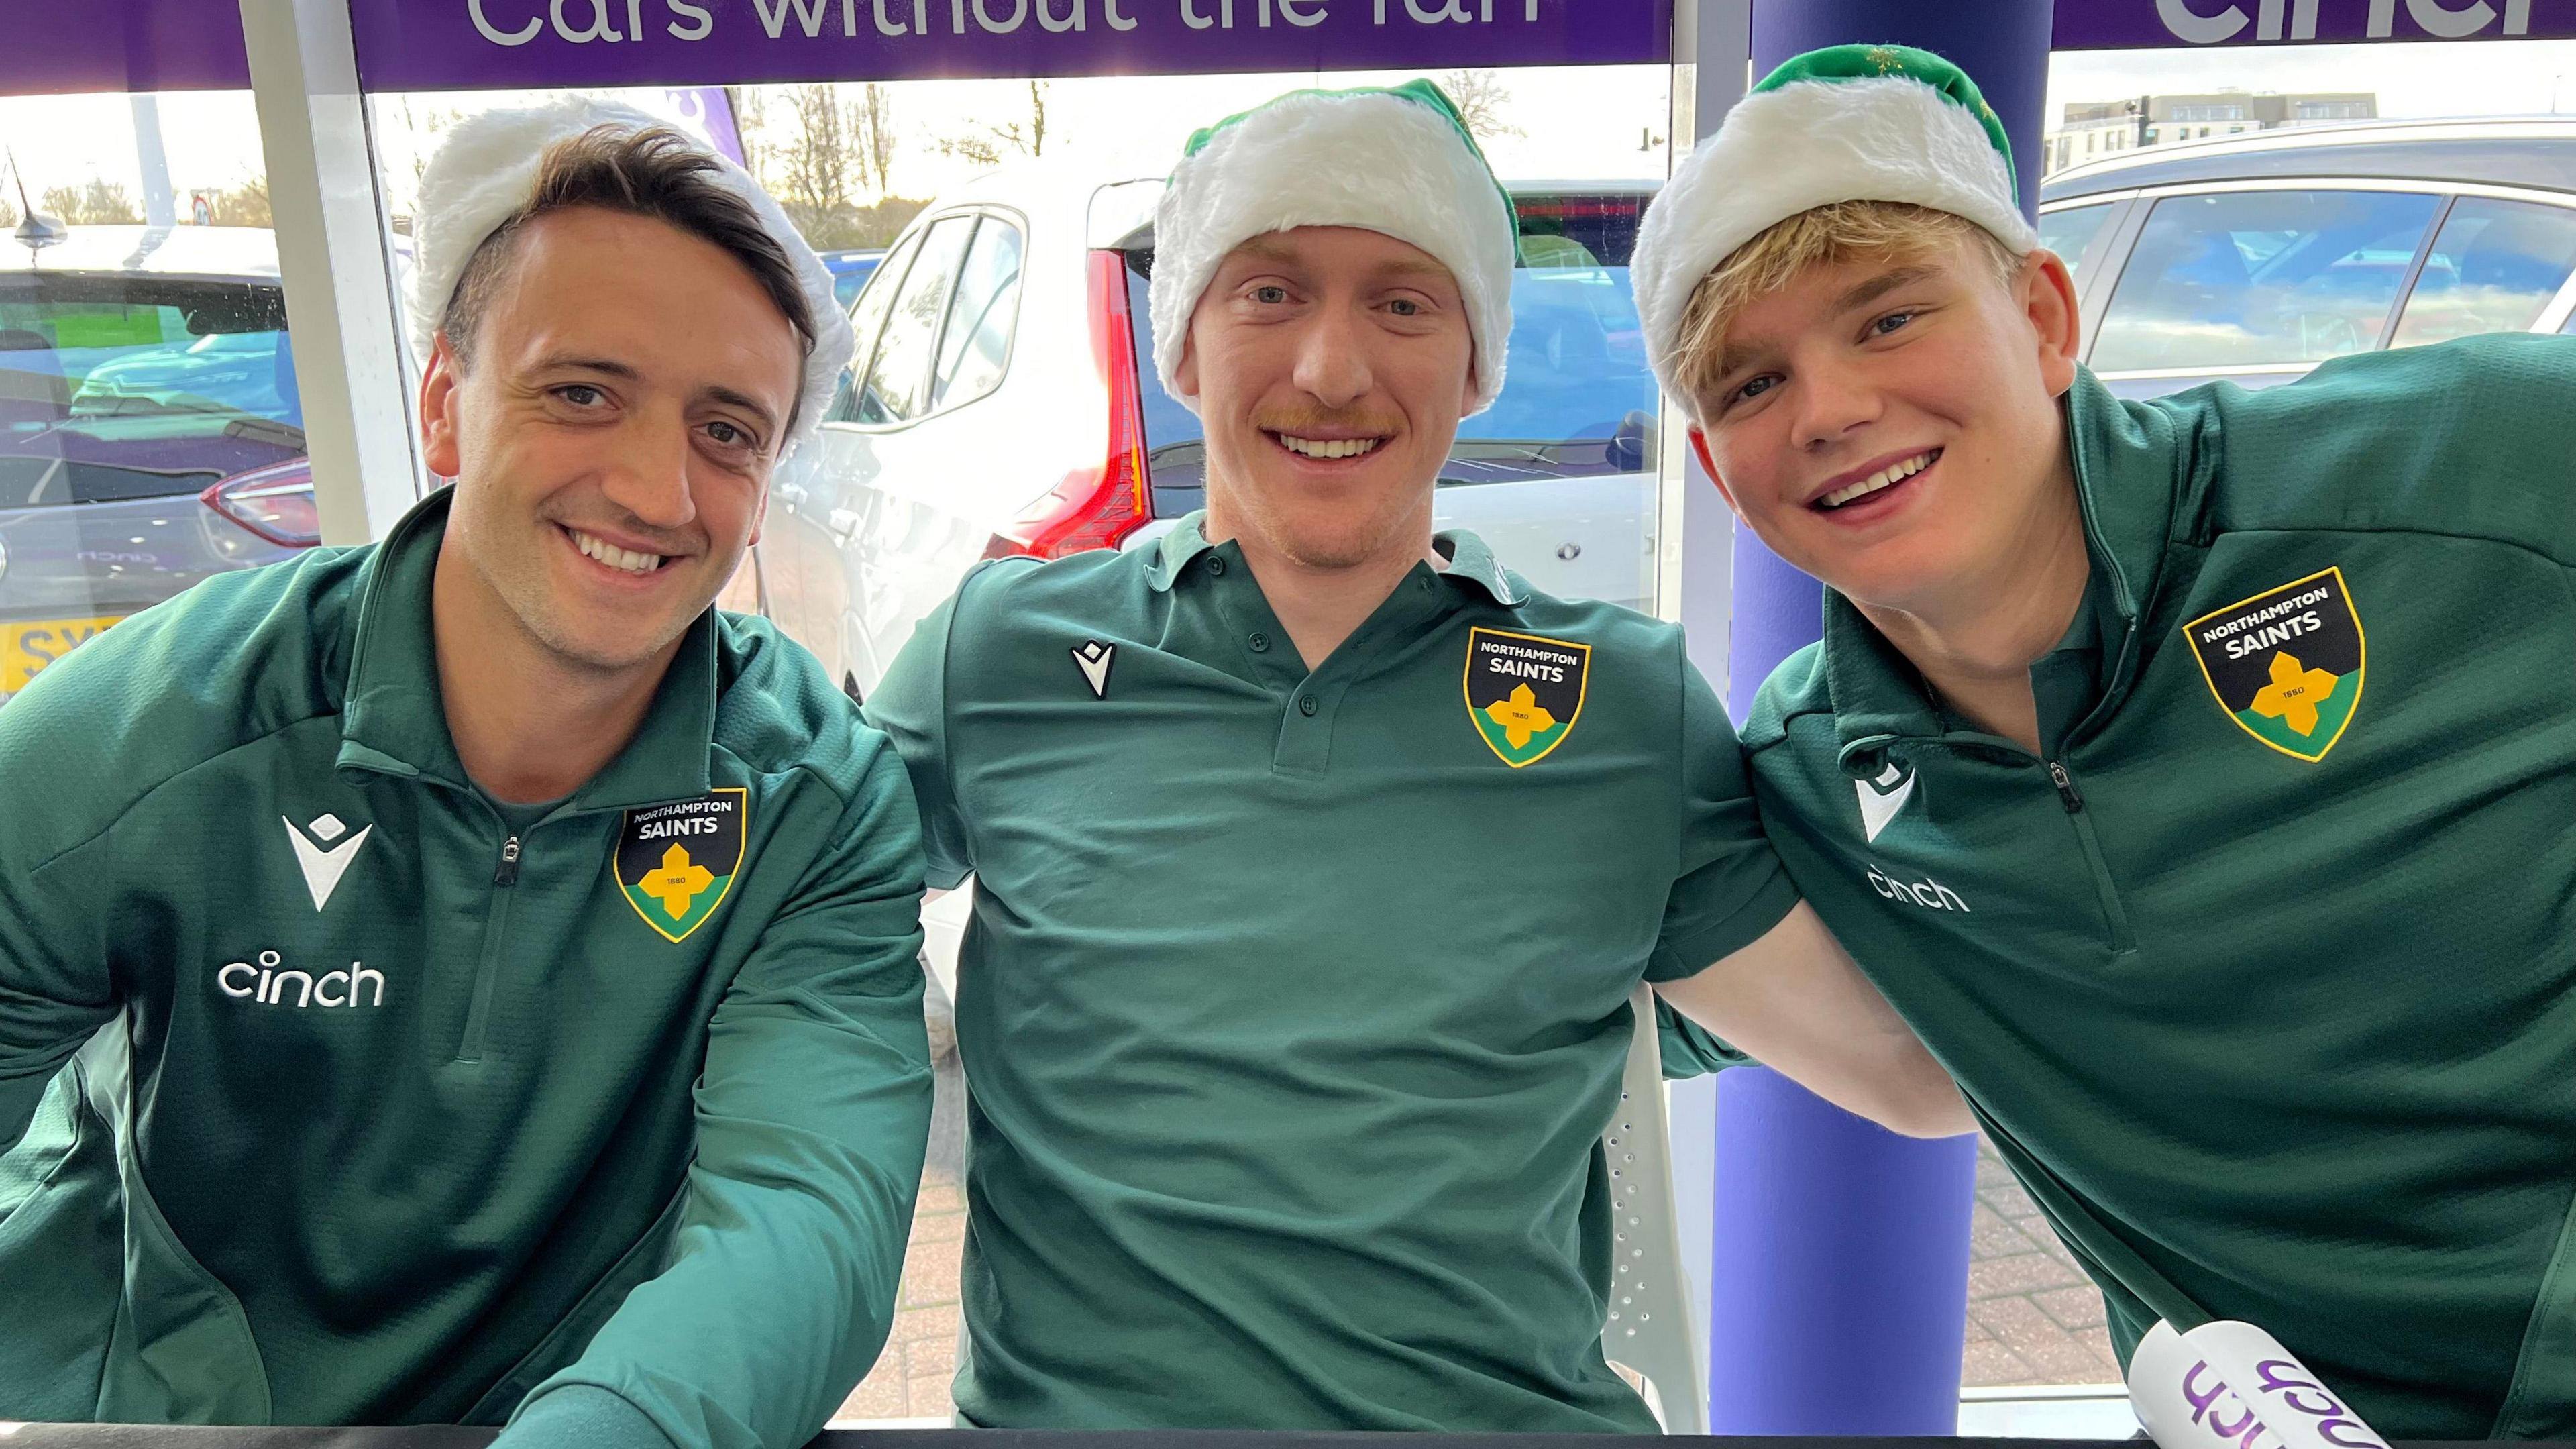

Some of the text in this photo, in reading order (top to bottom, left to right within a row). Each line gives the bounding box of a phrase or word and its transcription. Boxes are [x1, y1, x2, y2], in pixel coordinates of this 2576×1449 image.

[467, 0, 714, 46] Cars
[2203, 587, 2329, 643] NORTHAMPTON
[2225, 610, 2322, 659] SAINTS
[1481, 641, 1577, 665] NORTHAMPTON
[1489, 657, 1564, 683] SAINTS
[2282, 686, 2305, 699] 1880
[1512, 712, 1529, 720] 1880
[633, 801, 732, 824] NORTHAMPTON
[639, 816, 718, 840] SAINTS
[1867, 863, 1971, 912] cinch
[217, 950, 385, 1008] cinch
